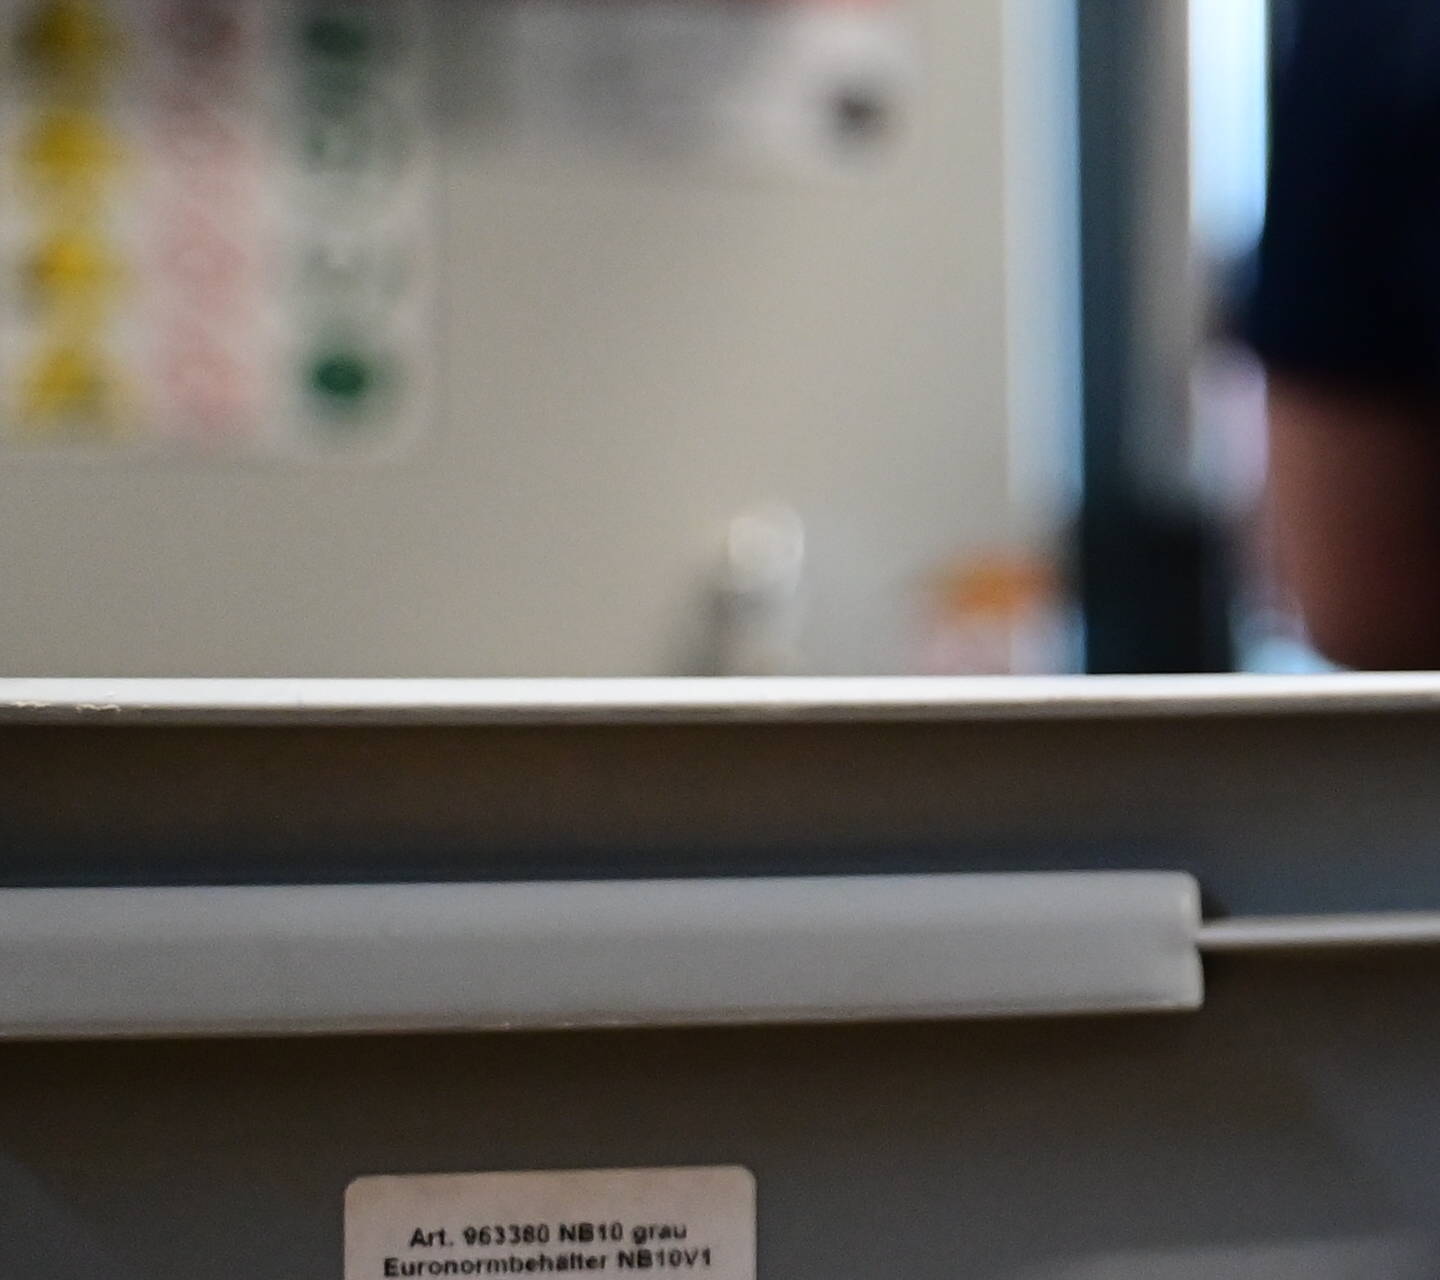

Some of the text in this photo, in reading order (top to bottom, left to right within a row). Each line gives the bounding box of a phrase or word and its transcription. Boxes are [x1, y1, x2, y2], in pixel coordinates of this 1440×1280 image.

[409, 1221, 687, 1249] Art. 963380 NB10 grau
[617, 1248, 713, 1270] NB10V1
